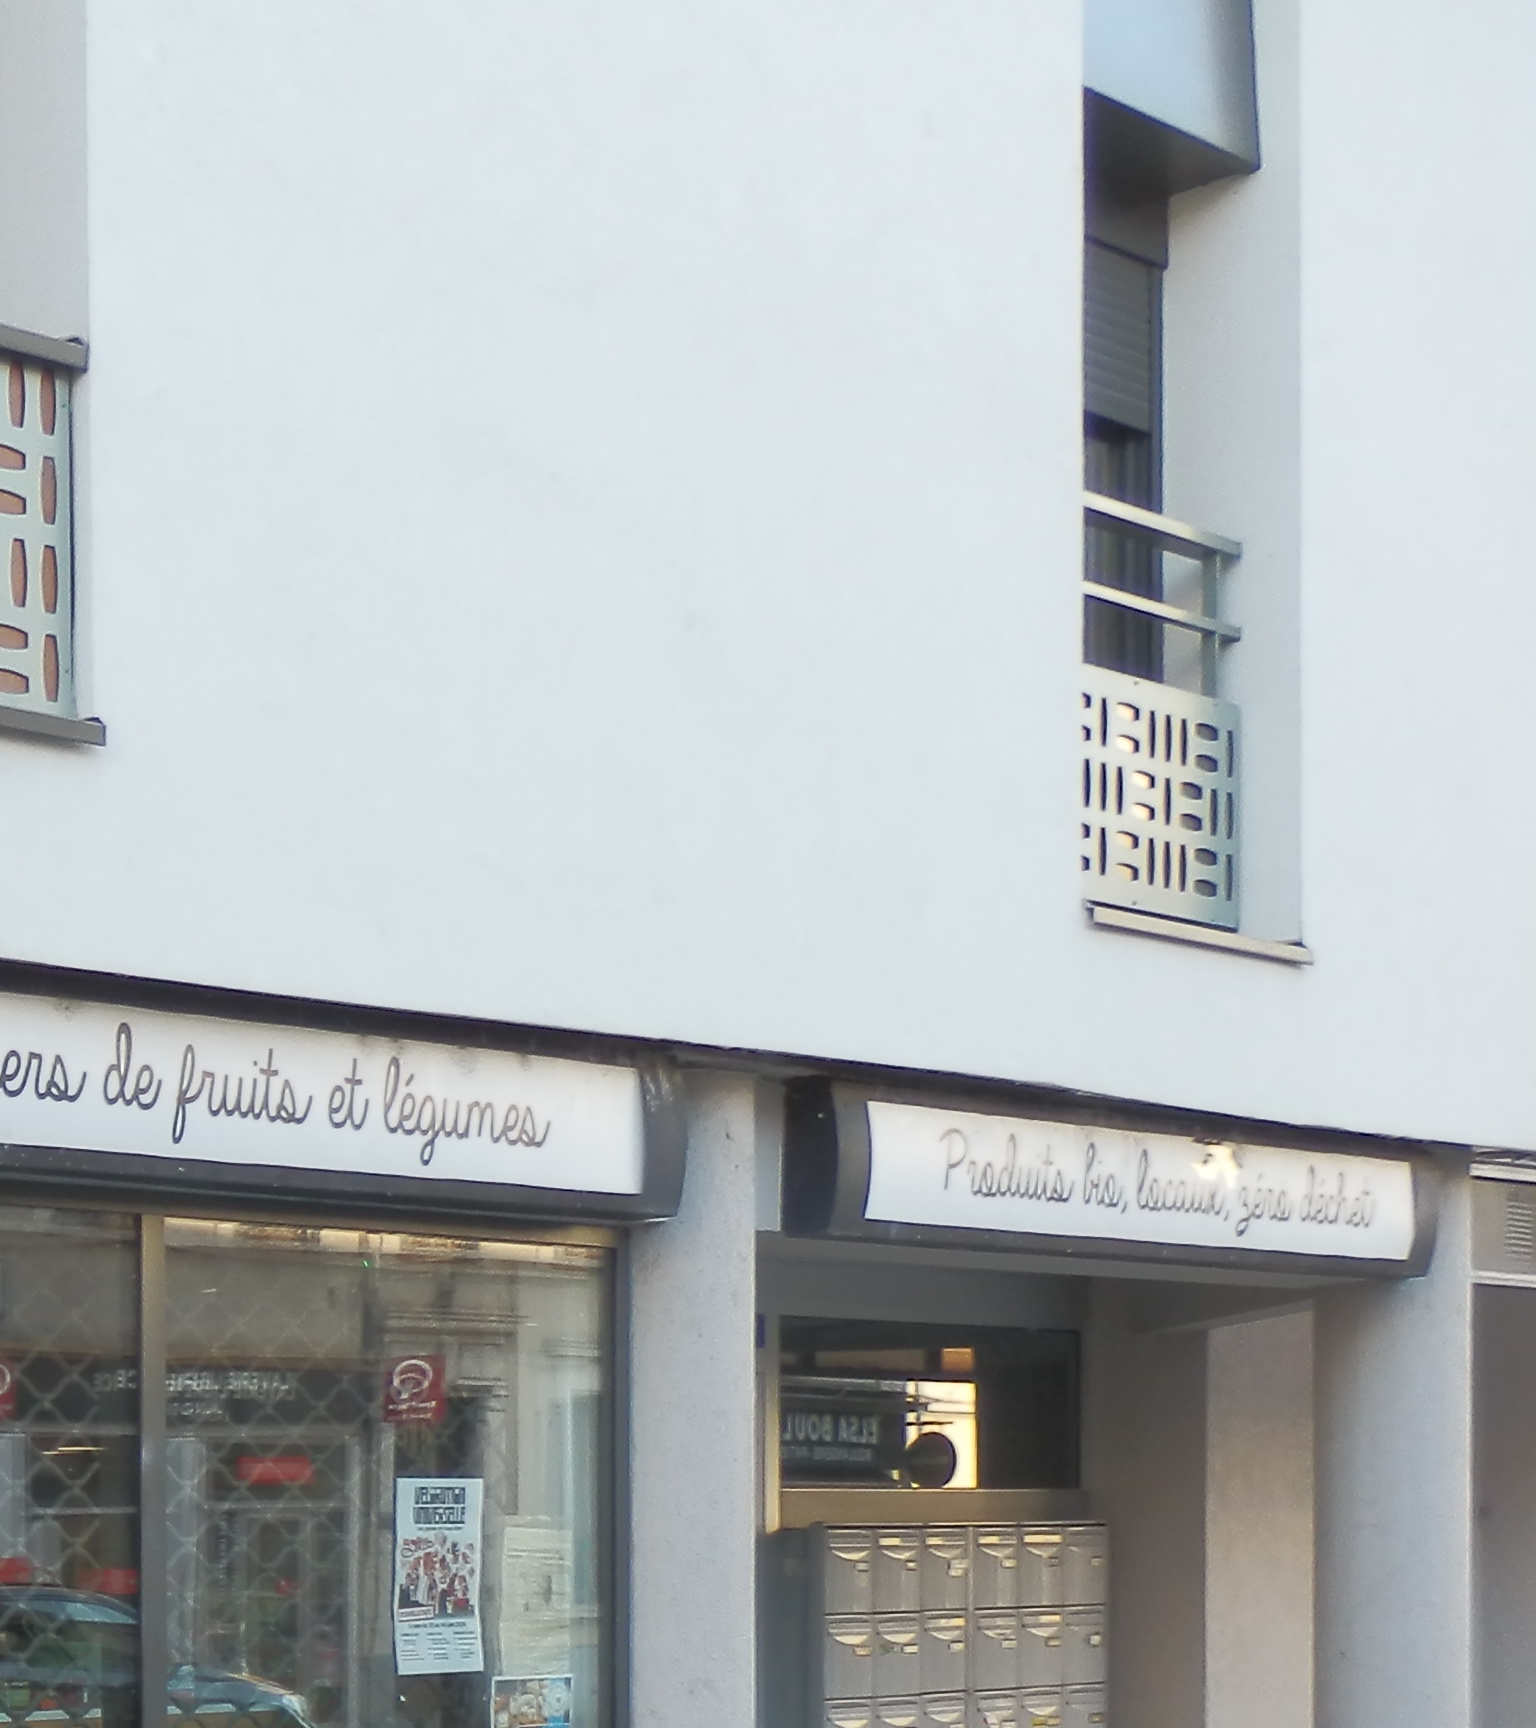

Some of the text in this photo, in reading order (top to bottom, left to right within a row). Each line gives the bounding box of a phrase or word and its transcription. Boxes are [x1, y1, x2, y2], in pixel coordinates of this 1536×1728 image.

[102, 1021, 161, 1111] de
[173, 1043, 314, 1145] fruits
[328, 1056, 370, 1132] et
[382, 1055, 551, 1167] légumes
[938, 1127, 1075, 1203] Produits
[1299, 1164, 1376, 1229] déchet
